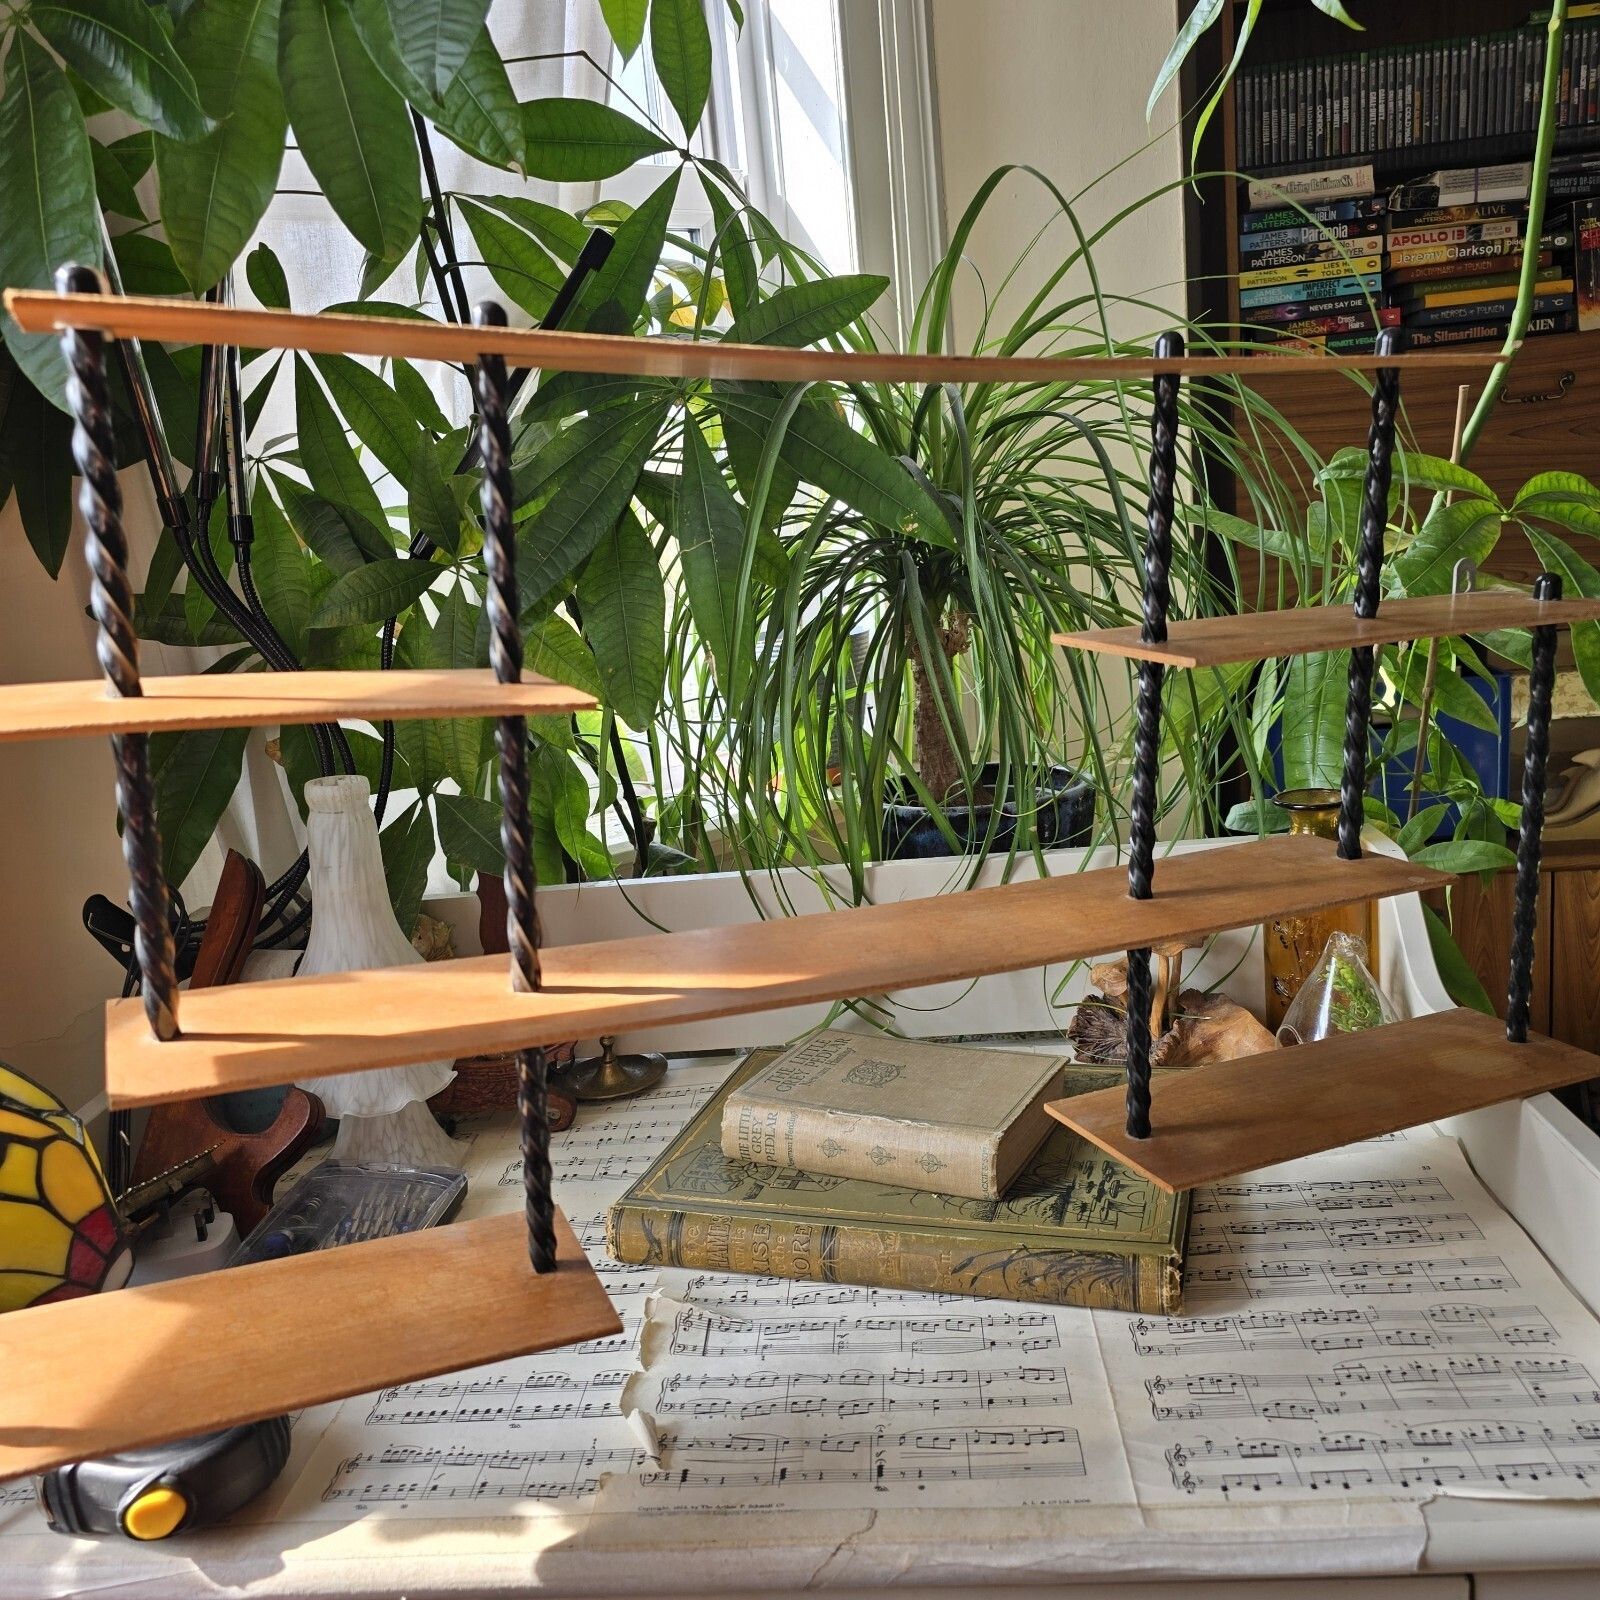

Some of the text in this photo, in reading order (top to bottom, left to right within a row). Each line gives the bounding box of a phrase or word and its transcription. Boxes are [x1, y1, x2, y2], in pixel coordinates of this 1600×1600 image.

[1263, 210, 1294, 221] JAMES
[1474, 205, 1506, 218] ALIVE
[1251, 217, 1306, 230] PATTERSON
[1249, 237, 1298, 249] PATTERSON
[1260, 231, 1288, 242] JAMES
[1391, 228, 1466, 248] APOLLO 13
[1262, 247, 1294, 259] JAMES
[1398, 243, 1503, 265] Jeremy Clarkson
[1251, 253, 1306, 268] PATTERSON
[1323, 261, 1340, 270] LIES
[1465, 259, 1492, 271] TOLKIEN
[1321, 269, 1342, 277] TOLD
[1246, 276, 1287, 286] PATTERSON
[1302, 279, 1341, 292] IMPERFECT
[1306, 288, 1337, 299] MURDER
[1309, 299, 1363, 312] NEVER SAY DIE
[1477, 304, 1506, 315] TOLKIEN
[1288, 319, 1317, 330] JAMES
[1411, 332, 1431, 344] The
[1434, 324, 1499, 343] Silmarillion
[764, 1040, 832, 1085] THE LITTLE
[776, 1039, 852, 1092] GREY PEDLAR
[739, 1105, 753, 1140] LITTLE
[752, 1116, 763, 1154] GREY
[764, 1111, 778, 1163] PEDLAR
[708, 1213, 733, 1271] HAMES
